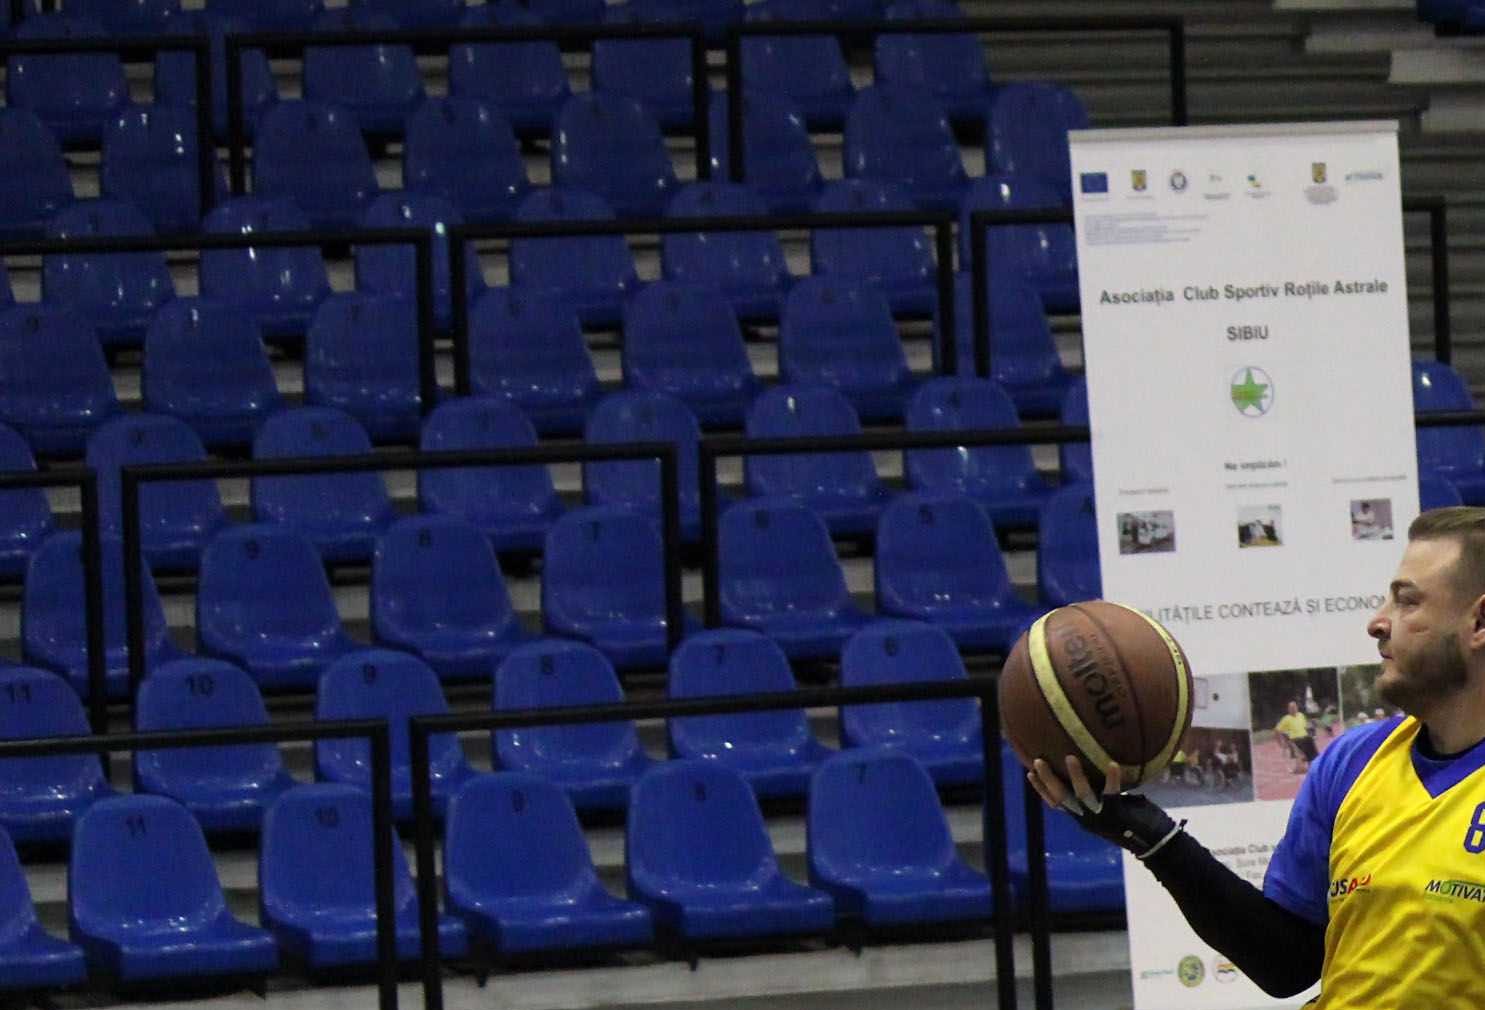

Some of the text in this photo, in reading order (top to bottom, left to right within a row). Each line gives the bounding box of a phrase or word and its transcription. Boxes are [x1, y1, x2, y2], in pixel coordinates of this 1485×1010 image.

[1183, 285, 1219, 301] Club
[1224, 283, 1279, 303] Sportiv
[1334, 277, 1389, 295] Astrale
[1226, 325, 1269, 341] SIBIU
[1218, 597, 1302, 619] CONTEAZĂ
[711, 643, 726, 667] 7
[184, 673, 217, 697] 10
